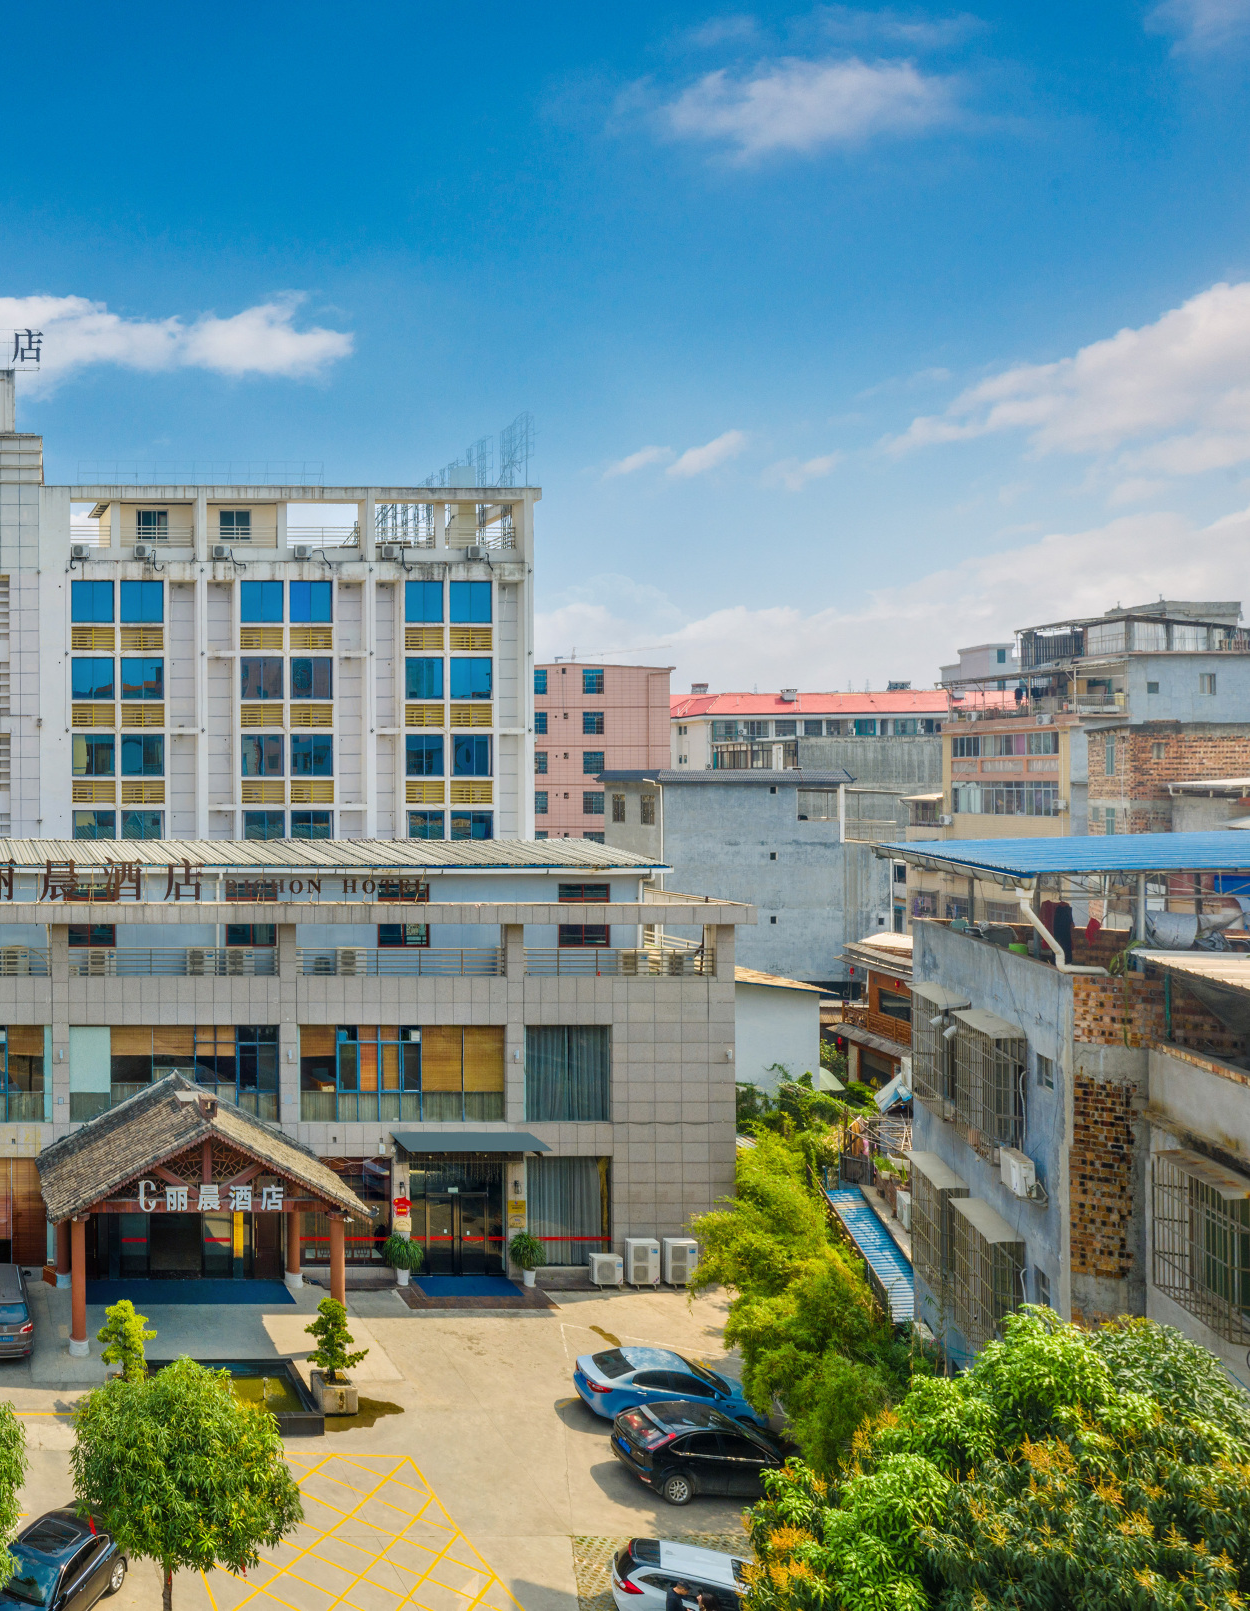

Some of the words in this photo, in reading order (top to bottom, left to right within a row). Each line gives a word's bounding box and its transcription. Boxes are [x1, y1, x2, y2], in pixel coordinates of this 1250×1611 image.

[225, 878, 322, 894] RICHON
[342, 878, 427, 894] HOTEL
[165, 1185, 284, 1211] 丽晨酒店
